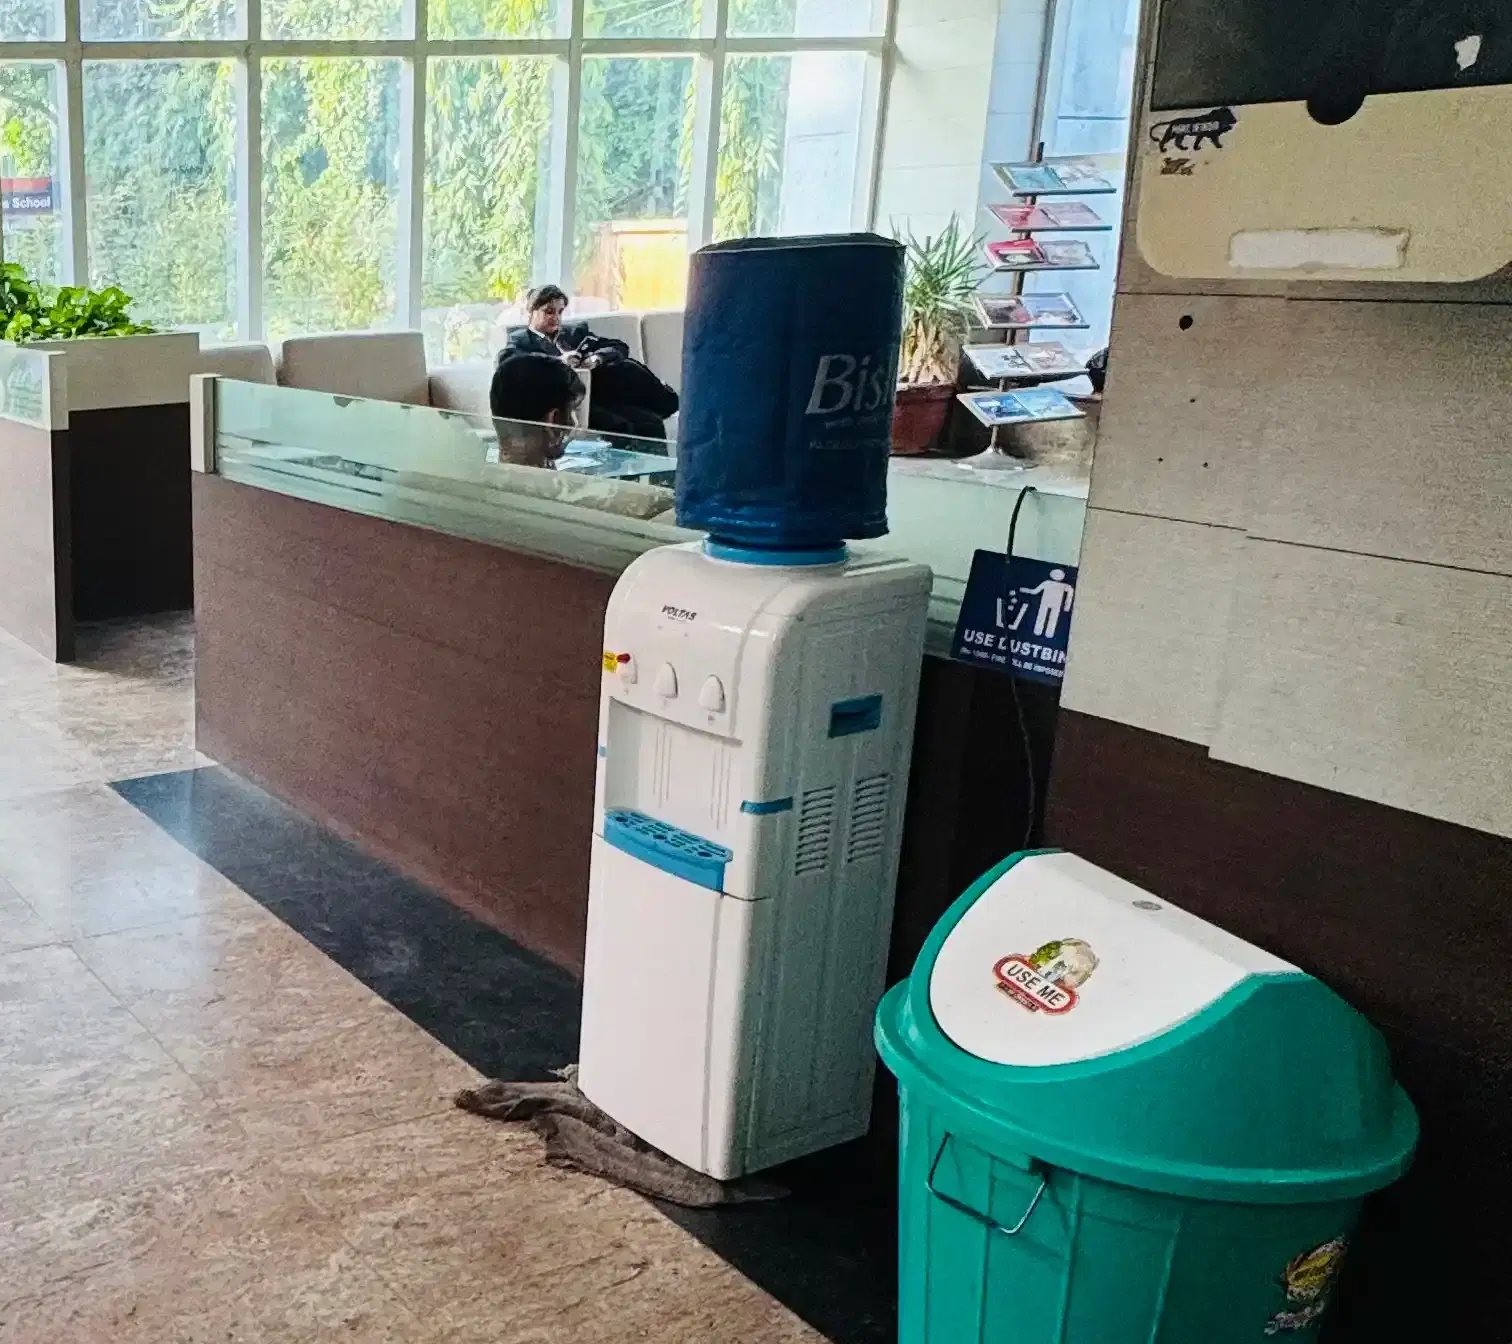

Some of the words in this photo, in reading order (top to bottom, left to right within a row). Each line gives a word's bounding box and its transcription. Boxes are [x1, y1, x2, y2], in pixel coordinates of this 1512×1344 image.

[12, 196, 51, 208] School
[662, 605, 697, 621] VOLTAS
[964, 628, 996, 647] USE
[1007, 964, 1041, 989] USE
[1036, 985, 1066, 1007] ME
